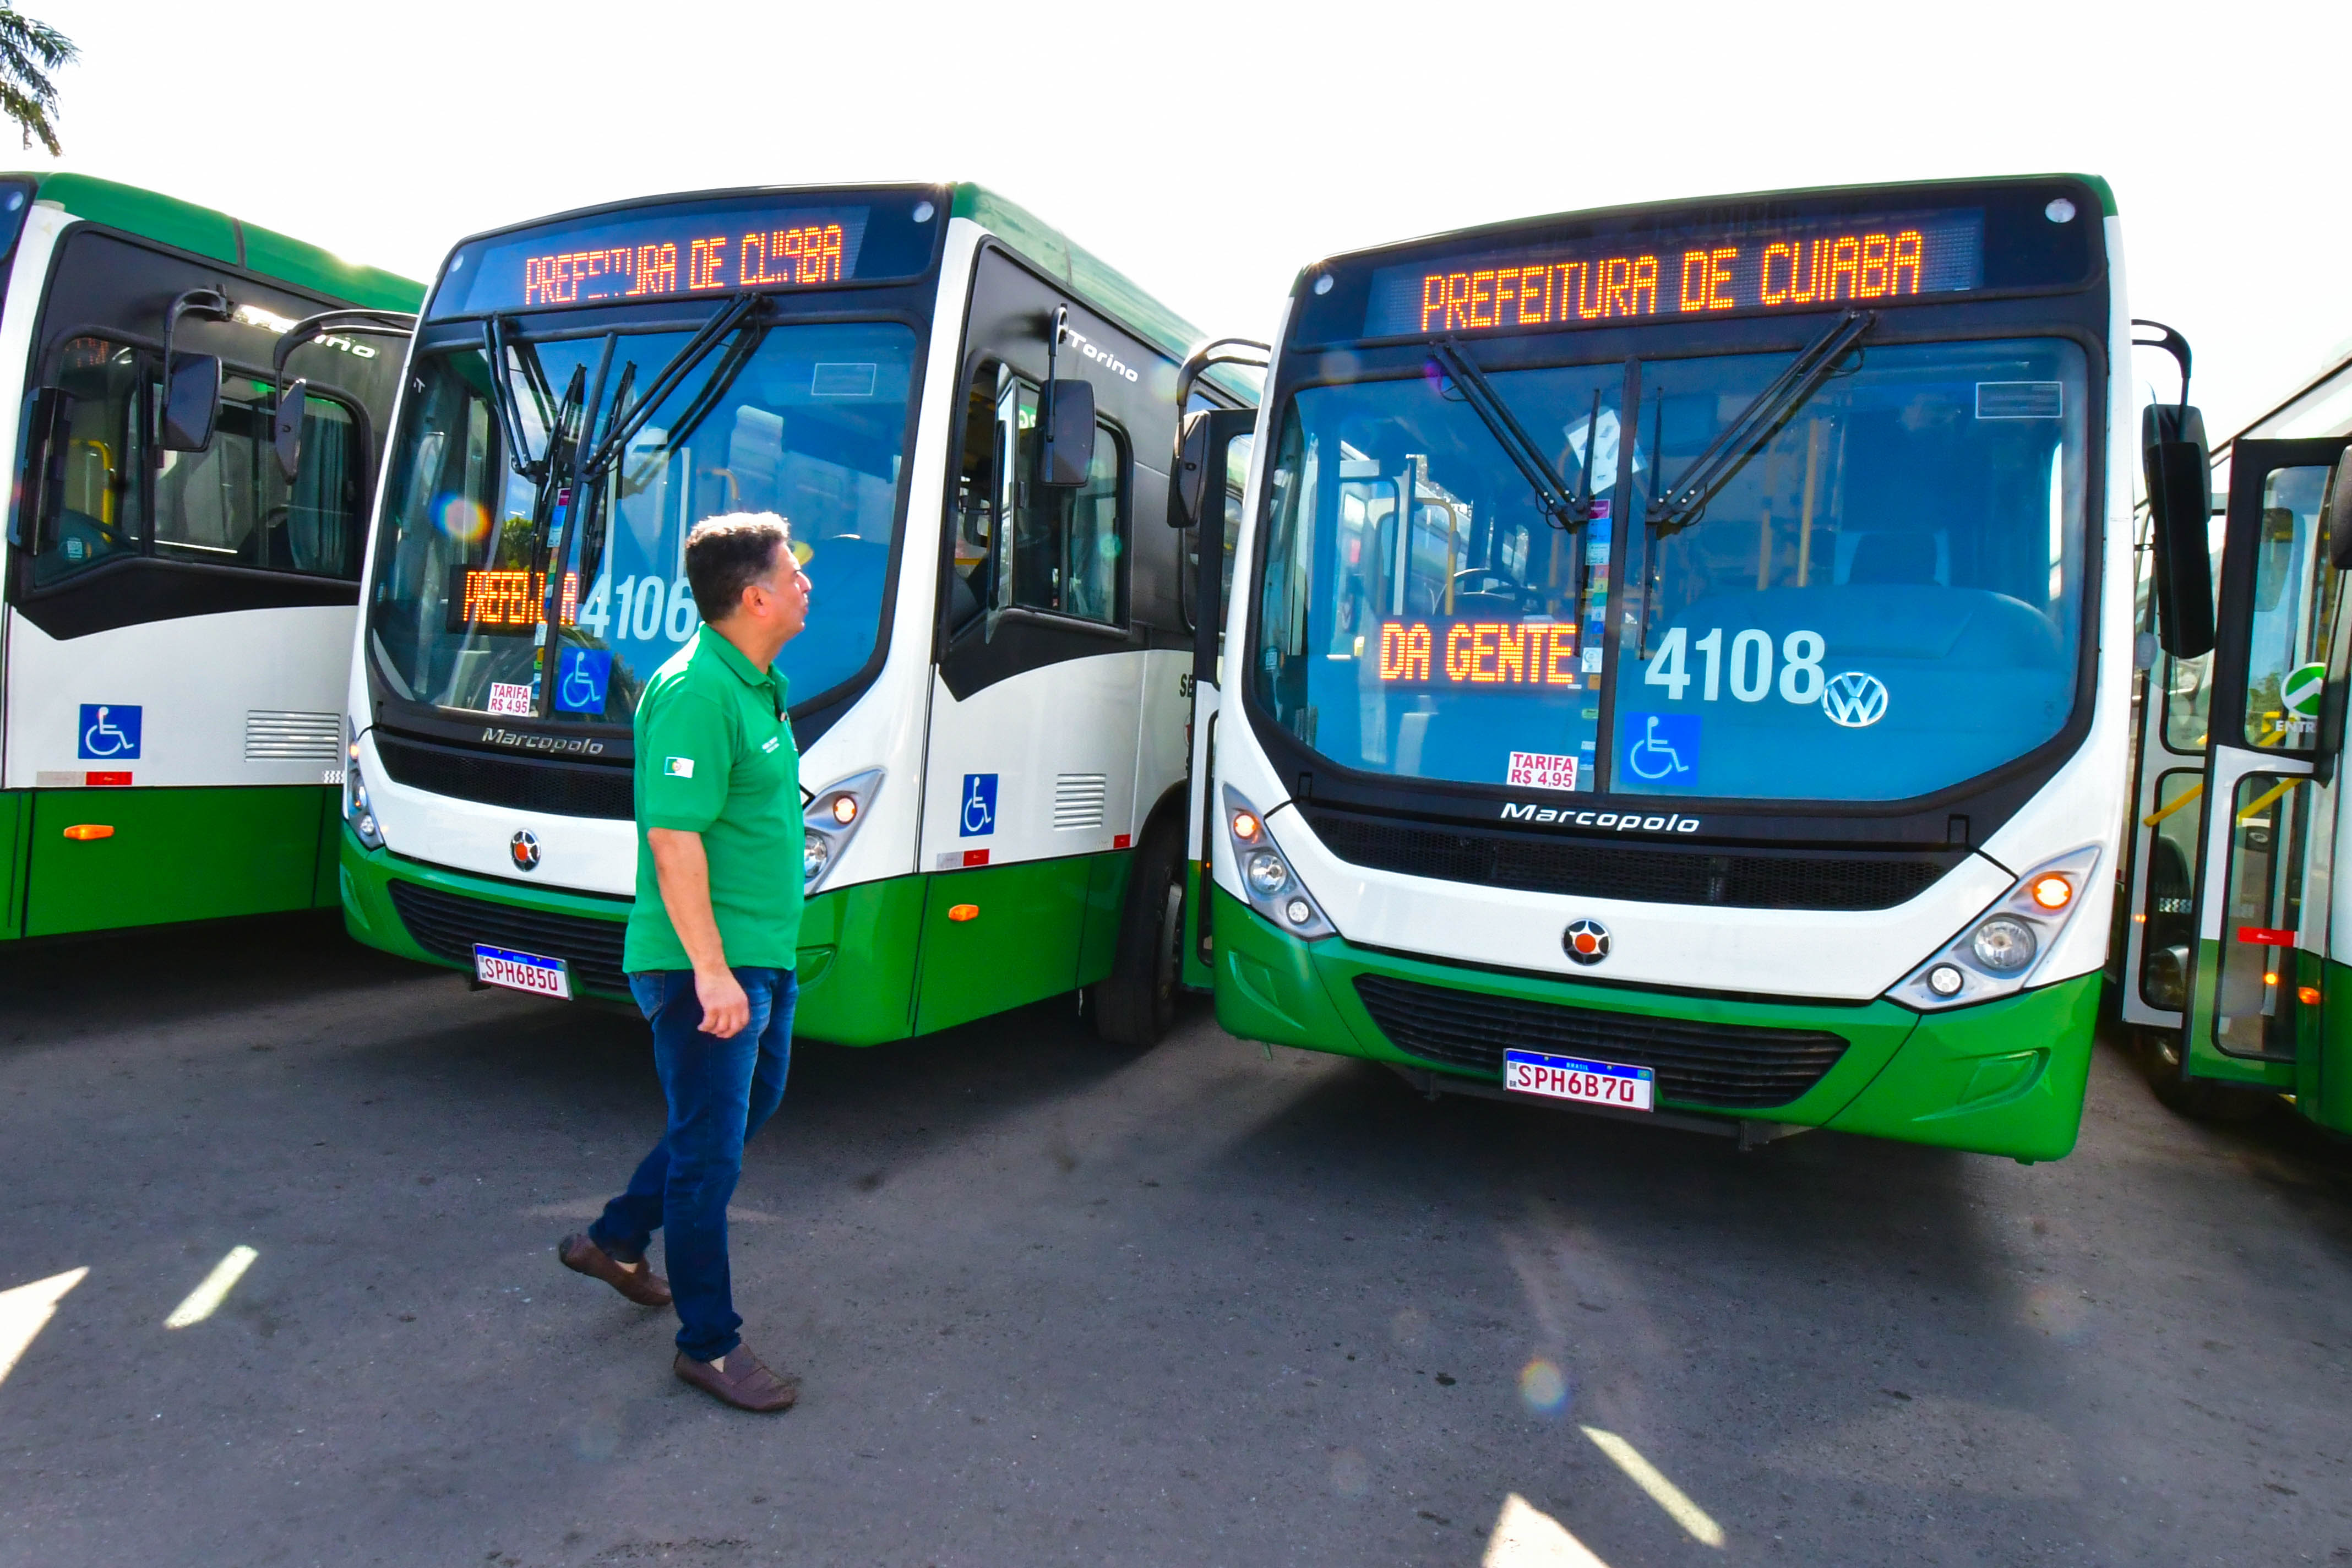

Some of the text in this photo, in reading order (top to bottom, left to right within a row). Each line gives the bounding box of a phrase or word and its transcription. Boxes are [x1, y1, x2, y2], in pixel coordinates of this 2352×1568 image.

[690, 237, 726, 289] DE
[1421, 230, 1922, 331] PREFEITURA DE CUIABA
[1069, 330, 1139, 383] Torino
[580, 574, 699, 642] 4106
[1381, 623, 1578, 684] DA GENTE
[1644, 627, 1826, 704] 4108
[494, 684, 529, 700] TARIFA
[507, 700, 527, 714] 4,95
[482, 728, 603, 755] Marcopolo
[1511, 769, 1573, 788] R$ 4,95
[1513, 753, 1574, 772] TARIFA
[1500, 803, 1700, 834] Marcopolo
[485, 959, 558, 990] SPH6B50
[1518, 1065, 1634, 1102] SPH6B70
